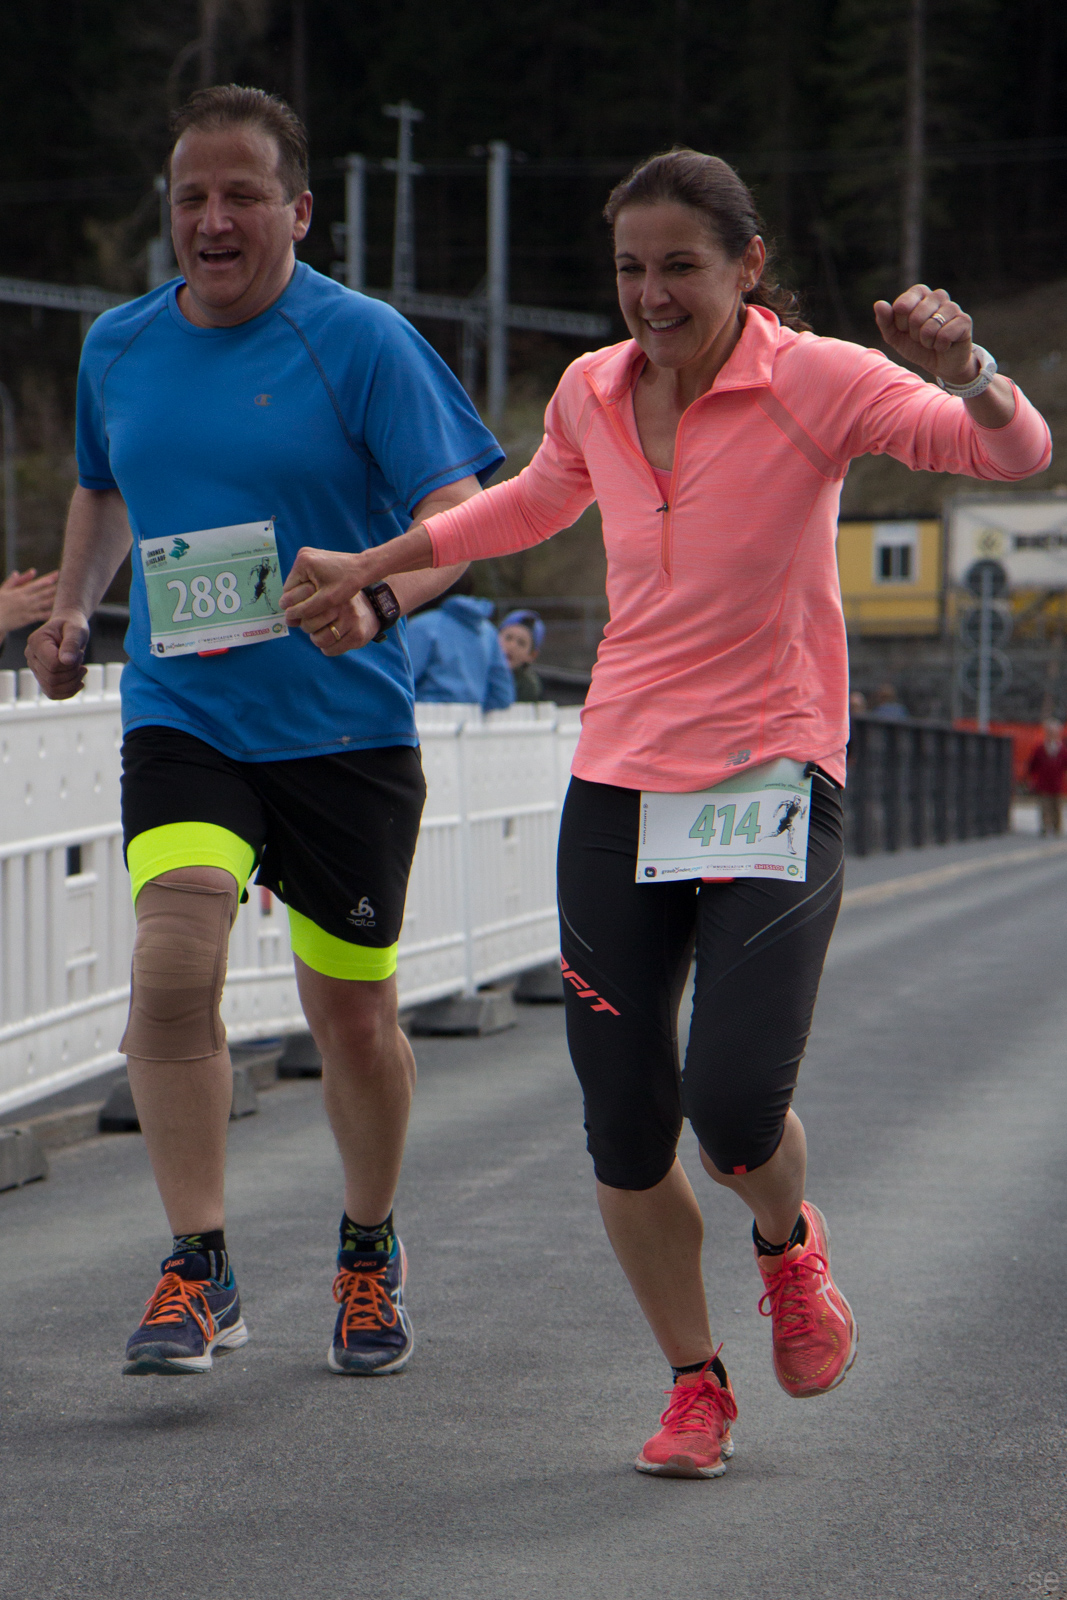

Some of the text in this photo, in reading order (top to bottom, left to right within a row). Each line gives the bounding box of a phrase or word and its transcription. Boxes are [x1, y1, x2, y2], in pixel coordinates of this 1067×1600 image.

[166, 568, 242, 623] 288
[688, 801, 762, 847] 414
[754, 863, 784, 872] SWISSLOS
[170, 1258, 185, 1268] asics
